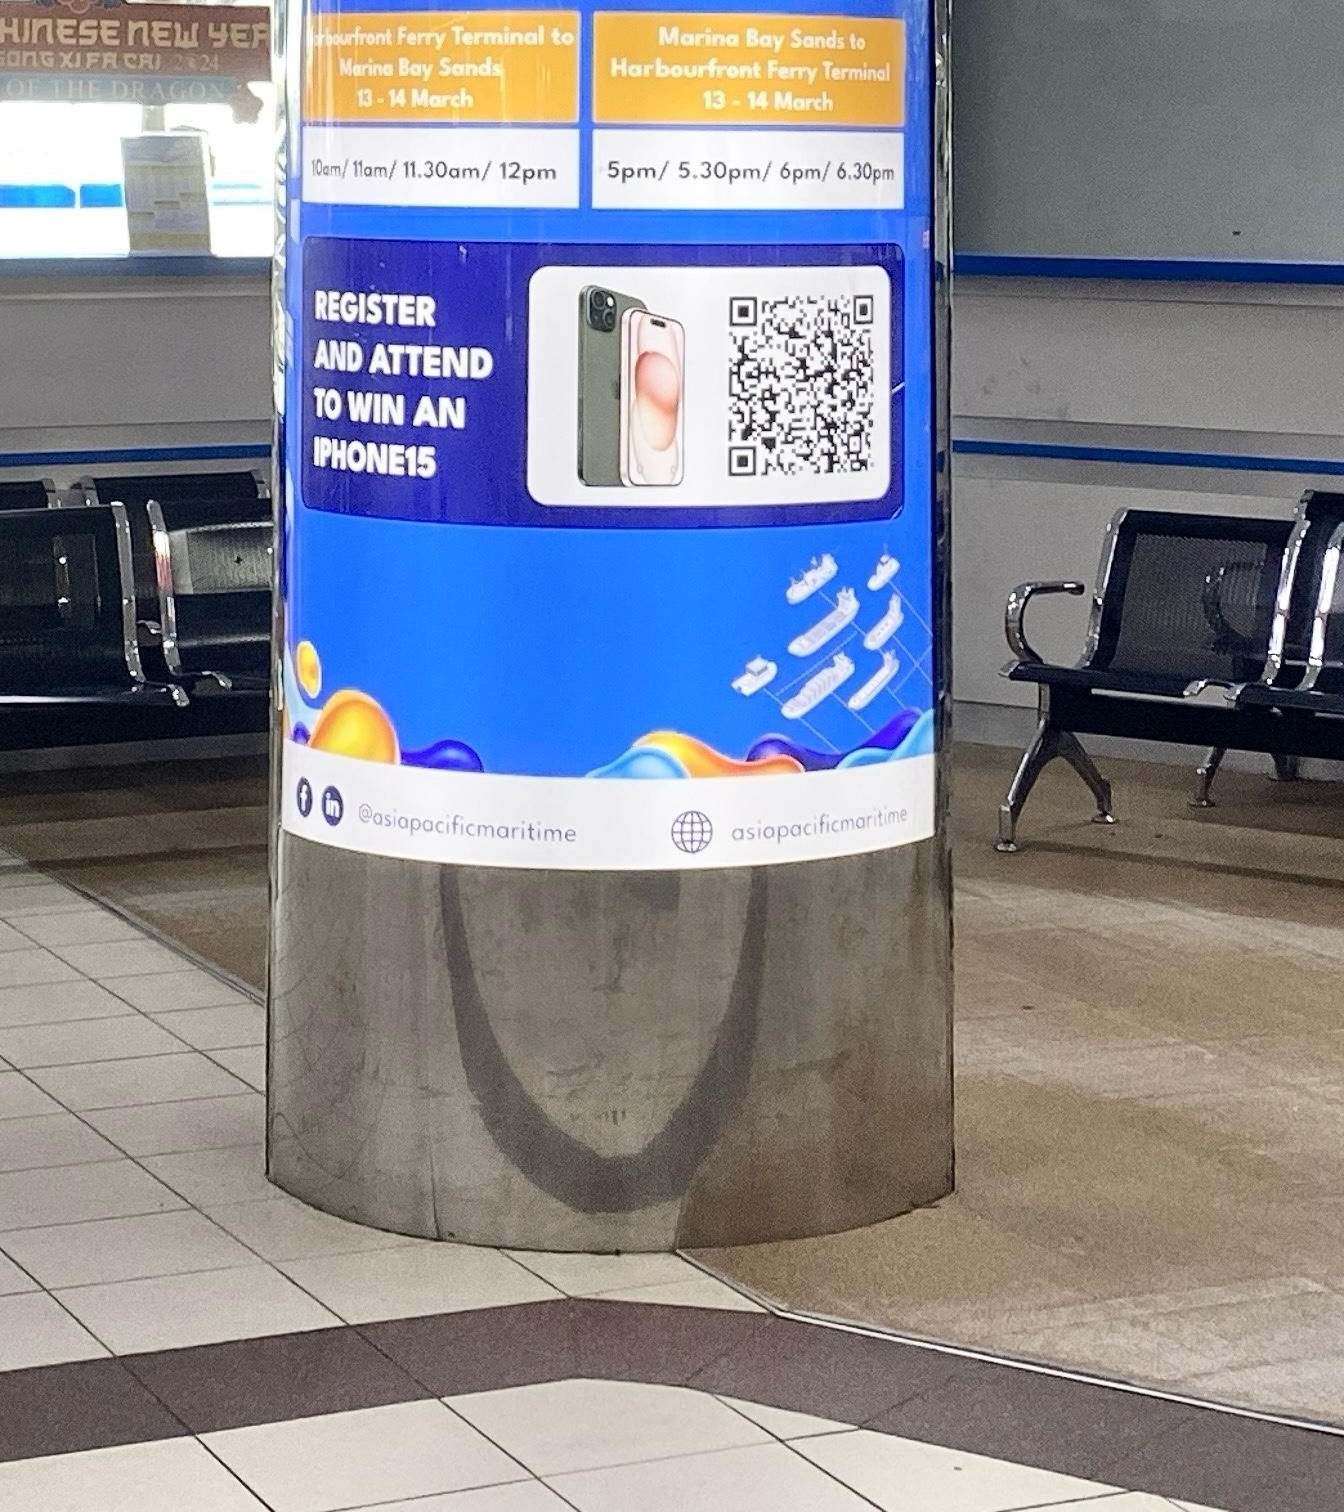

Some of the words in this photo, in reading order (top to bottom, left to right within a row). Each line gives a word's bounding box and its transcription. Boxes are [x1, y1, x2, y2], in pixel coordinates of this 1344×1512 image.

[128, 18, 198, 48] NEW
[398, 27, 446, 50] Ferry
[451, 25, 545, 46] Terminal
[551, 27, 575, 46] to
[658, 26, 740, 48] Marina
[746, 27, 785, 51] Bay
[790, 29, 845, 50] Sands
[849, 33, 866, 50] to
[339, 58, 393, 78] Marina
[399, 58, 433, 81] Bay
[438, 56, 502, 78] Sands
[610, 57, 762, 80] Harbourfront
[767, 60, 818, 85] Ferry
[822, 61, 891, 82] Terminal
[357, 90, 373, 108] 13
[389, 89, 406, 108] 14
[411, 88, 474, 109] March
[703, 90, 726, 110] 13
[747, 90, 769, 110] 14
[774, 91, 834, 112] March
[353, 159, 397, 181] 11am/
[403, 160, 492, 181] 11.30am/
[500, 161, 557, 185] 12pm
[607, 160, 670, 184] 5pm/
[678, 161, 772, 185] 5.30pm/
[779, 161, 831, 185] 6pm/
[837, 162, 895, 186] 6.30pm
[314, 290, 436, 327] REGISTER
[313, 339, 363, 373] AND
[368, 343, 494, 380] ATTEND
[313, 387, 343, 421] TO
[347, 390, 405, 426] WIN
[412, 395, 466, 430] AN
[313, 436, 438, 480] IPHONE15
[357, 802, 577, 844] @asiapacificmaritime
[731, 806, 909, 844] asiapacificmaritime
